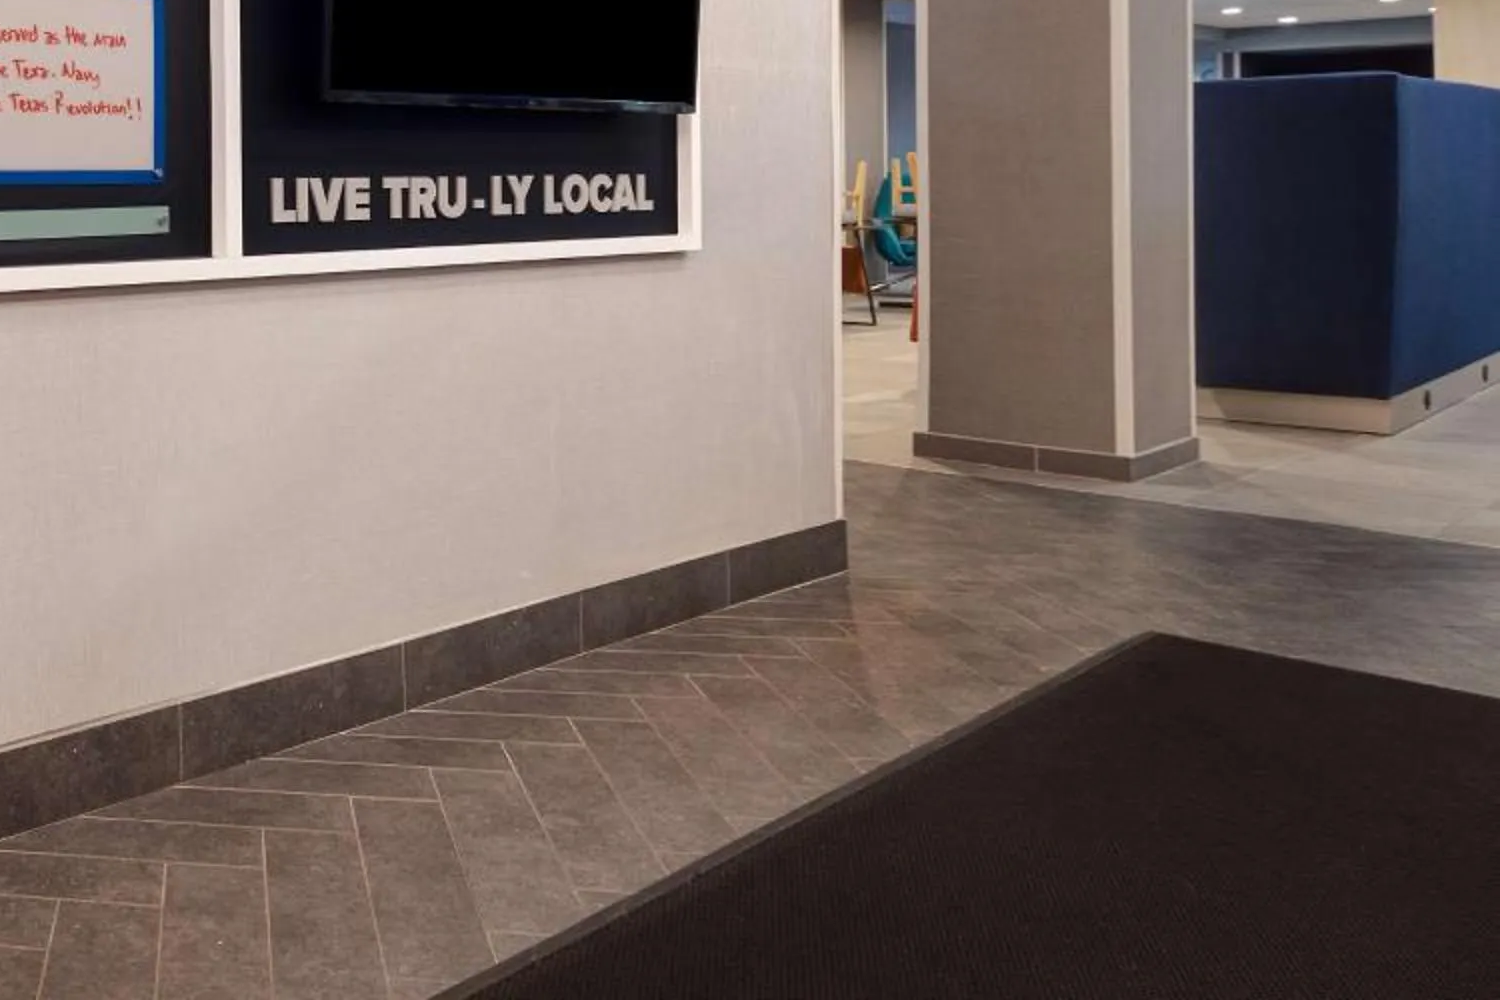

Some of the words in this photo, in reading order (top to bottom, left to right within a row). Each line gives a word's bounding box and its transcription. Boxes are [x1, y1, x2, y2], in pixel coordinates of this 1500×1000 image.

[65, 24, 88, 47] the
[269, 175, 372, 224] LIVE
[542, 172, 655, 217] LOCAL
